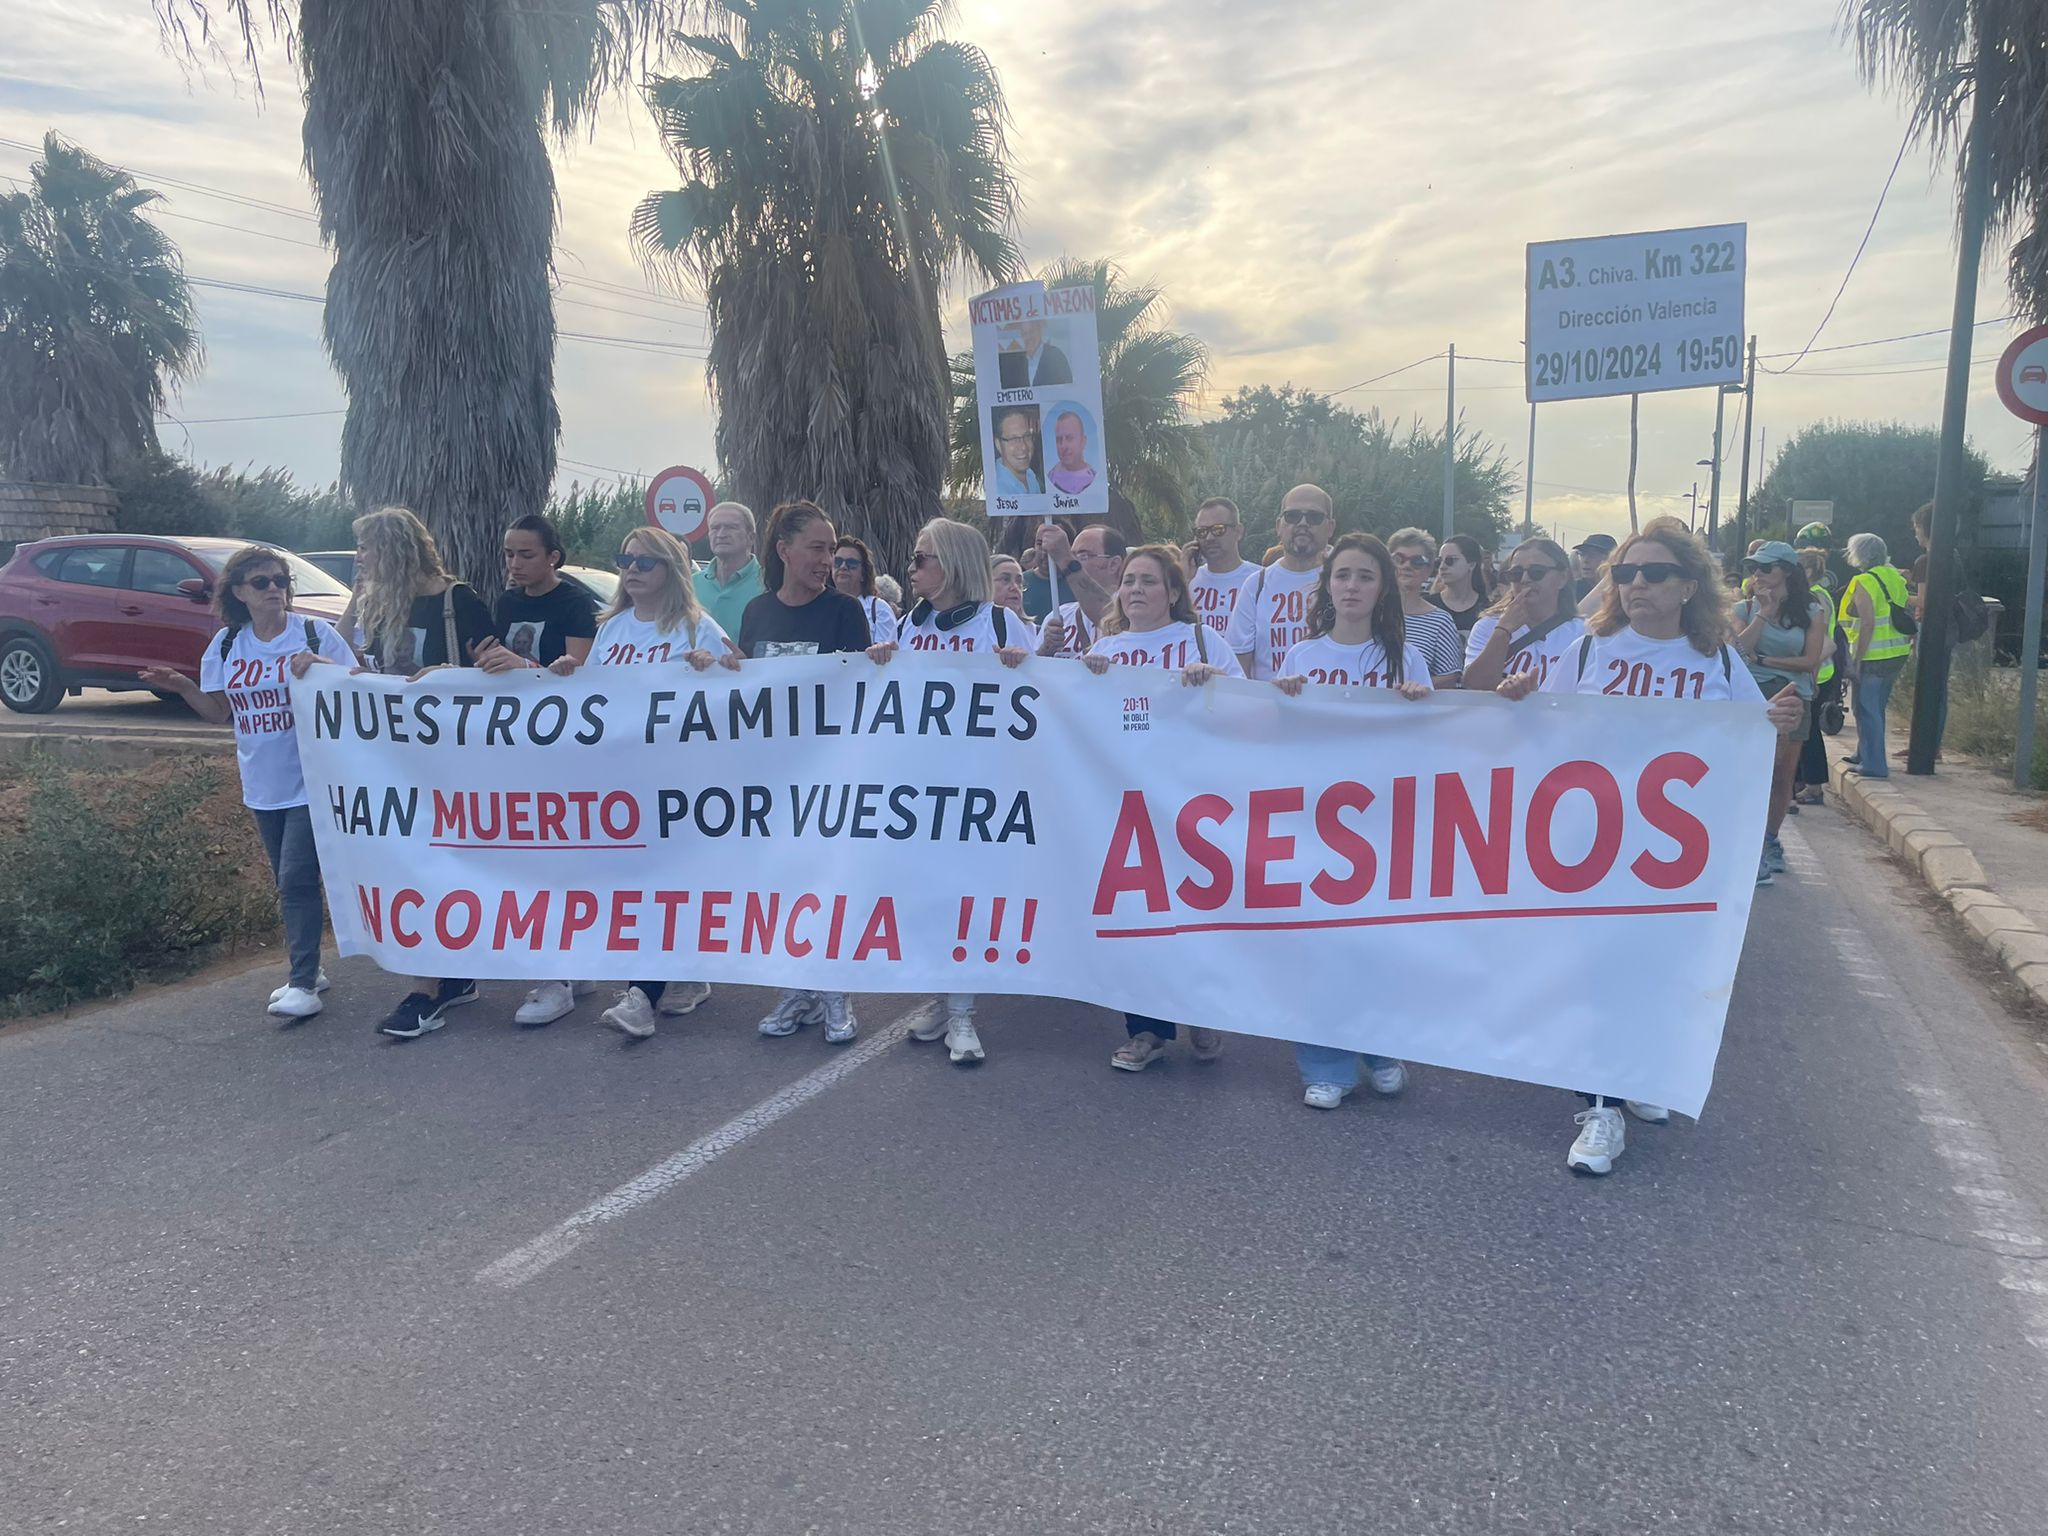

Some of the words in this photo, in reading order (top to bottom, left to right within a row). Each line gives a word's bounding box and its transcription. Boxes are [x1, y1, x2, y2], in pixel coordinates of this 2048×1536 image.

[1538, 257, 1581, 290] A3.
[1588, 266, 1638, 285] Chiva.
[1645, 248, 1682, 279] Km
[1690, 241, 1735, 275] 322
[968, 296, 1022, 325] VICTIMAS
[1559, 304, 1642, 328] Dirección
[1647, 298, 1717, 320] Valencia
[1535, 341, 1661, 386] 29/10/2024
[1677, 335, 1738, 372] 19:50
[1193, 587, 1238, 612] 20:1
[1270, 627, 1287, 648] NI
[227, 655, 296, 689] 20:1
[1602, 658, 1705, 700] 20:11
[230, 692, 250, 712] NI
[251, 686, 291, 710] OBLI
[315, 690, 609, 746] NUESTROS
[645, 680, 1041, 742] FAMILIARES
[1123, 697, 1149, 712] 20:11
[328, 784, 418, 837] HAN
[432, 789, 640, 841] MUERTO
[658, 785, 773, 839] POR
[790, 784, 1037, 846] VUESTRA
[1092, 751, 1710, 916] ASESINOS
[358, 884, 902, 962] NCOMPETENCIA
[952, 896, 1038, 965] !!!
